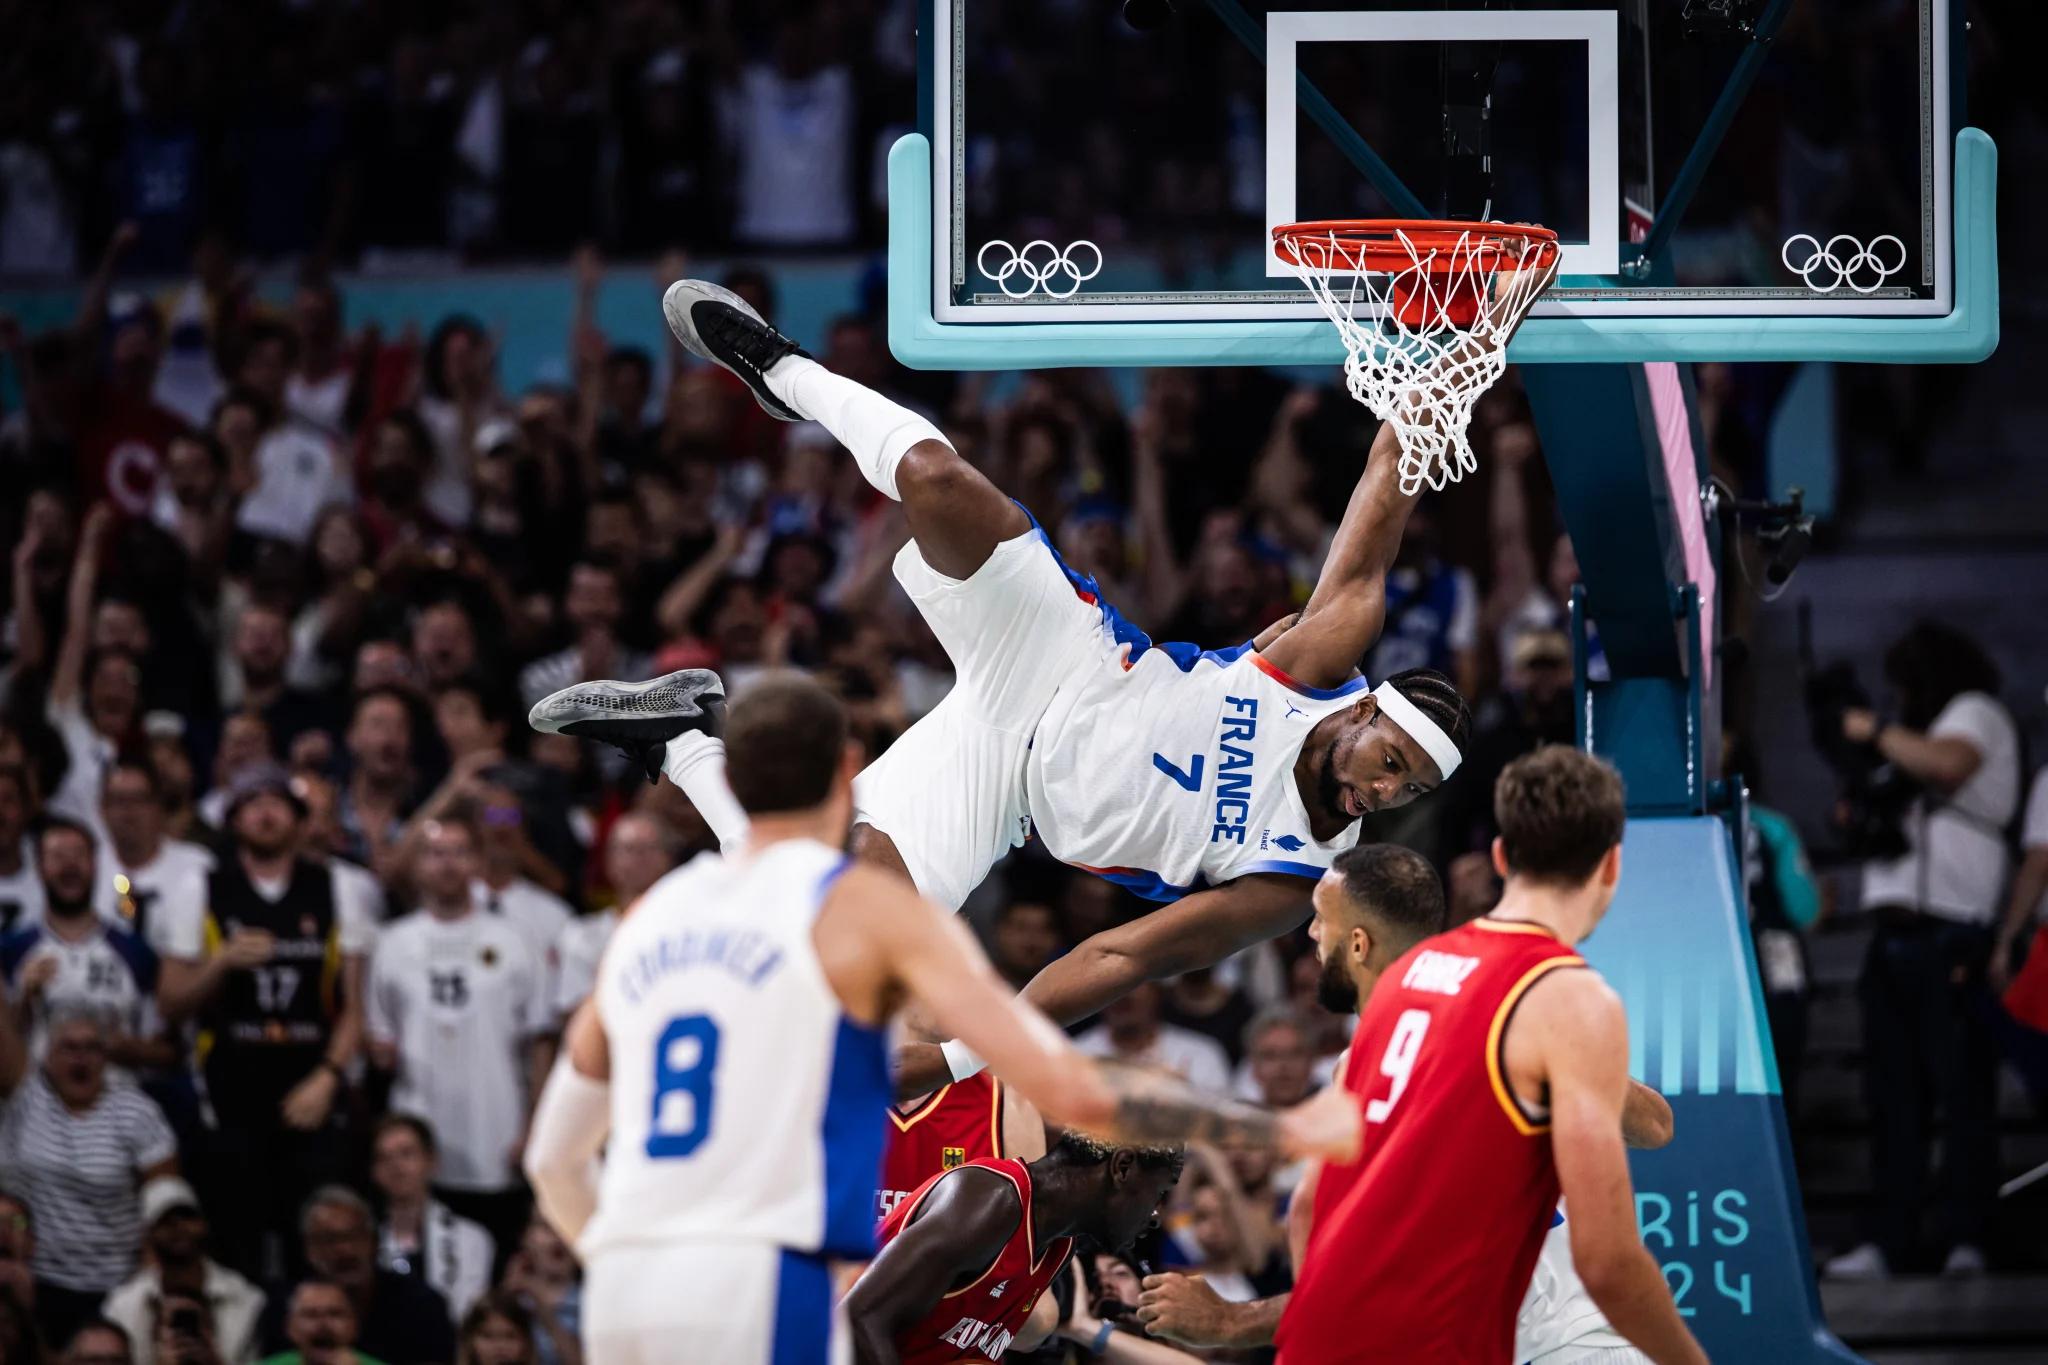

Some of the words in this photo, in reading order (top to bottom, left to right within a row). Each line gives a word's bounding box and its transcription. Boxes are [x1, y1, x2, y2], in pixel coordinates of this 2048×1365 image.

[1153, 752, 1204, 792] 7
[1211, 695, 1258, 845] FRANCE
[1260, 829, 1271, 851] FRANCE
[646, 1013, 720, 1158] 8
[1364, 1008, 1431, 1124] 9
[1634, 1189, 1749, 1247] RiS
[1662, 1260, 1751, 1316] 24
